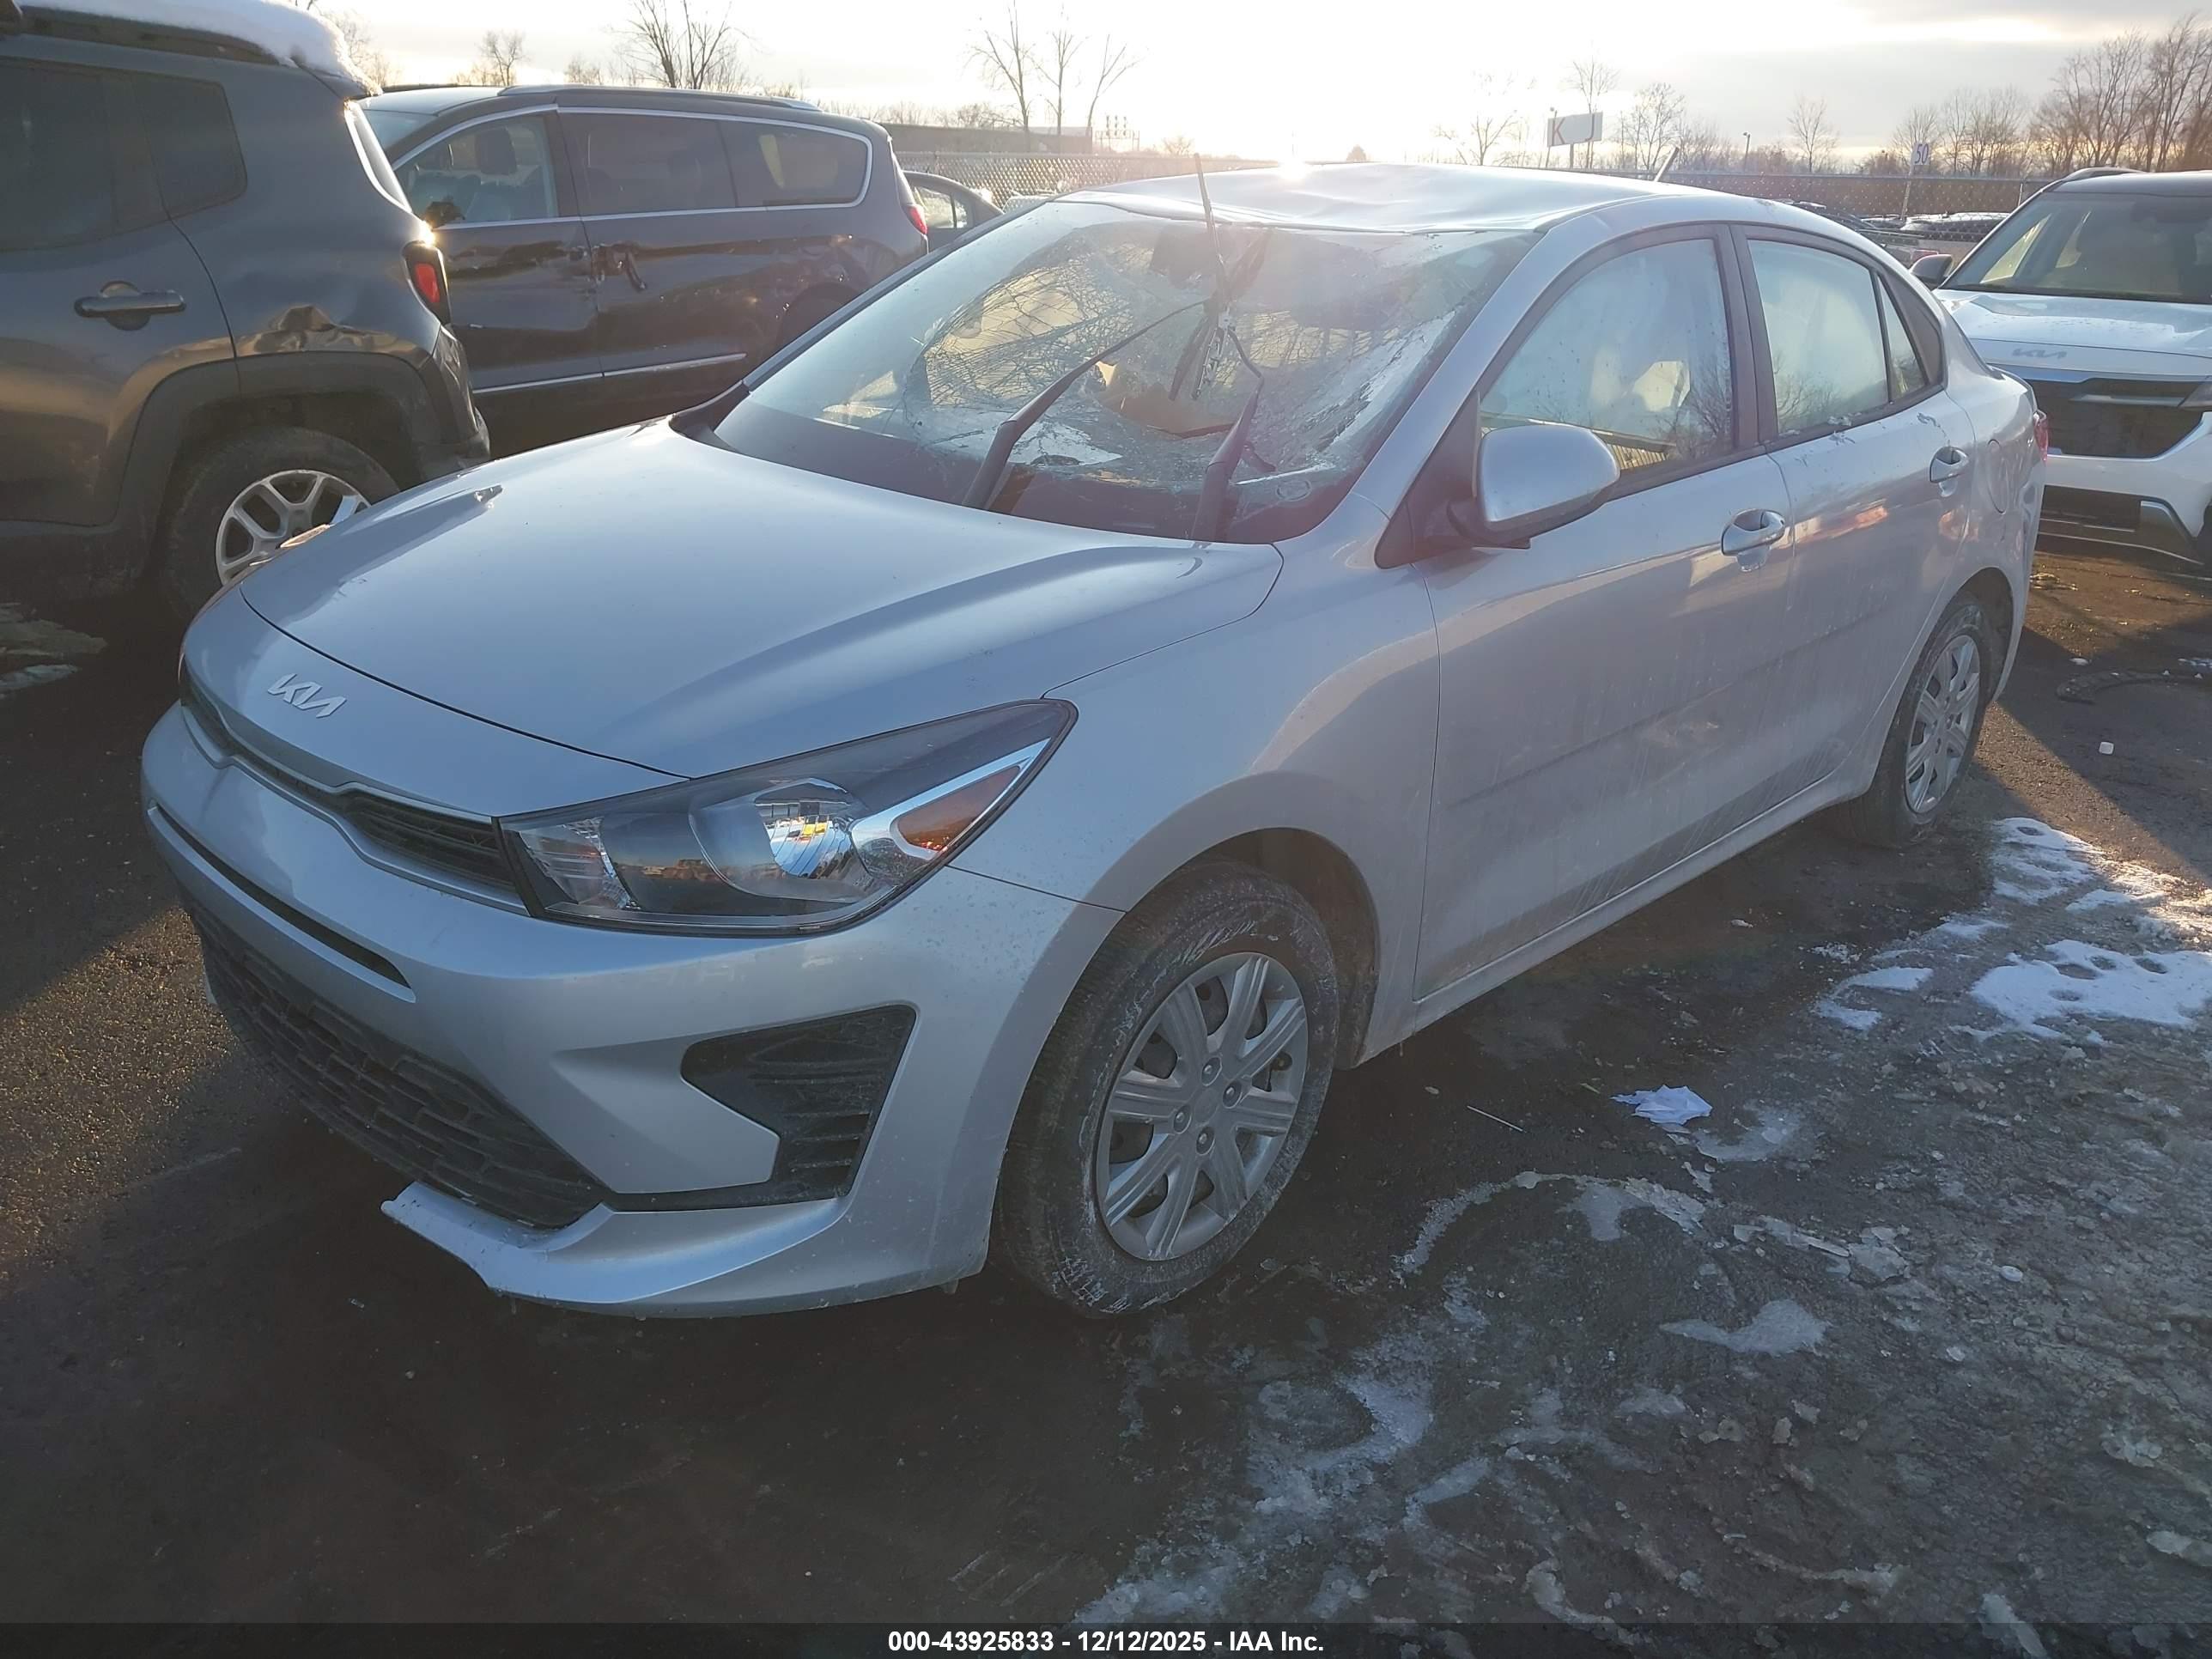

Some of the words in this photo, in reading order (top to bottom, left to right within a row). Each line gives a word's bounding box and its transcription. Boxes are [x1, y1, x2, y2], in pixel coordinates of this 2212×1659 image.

[1914, 143, 1929, 164] 50
[2011, 348, 2068, 359] KIA
[267, 673, 348, 719] KIA
